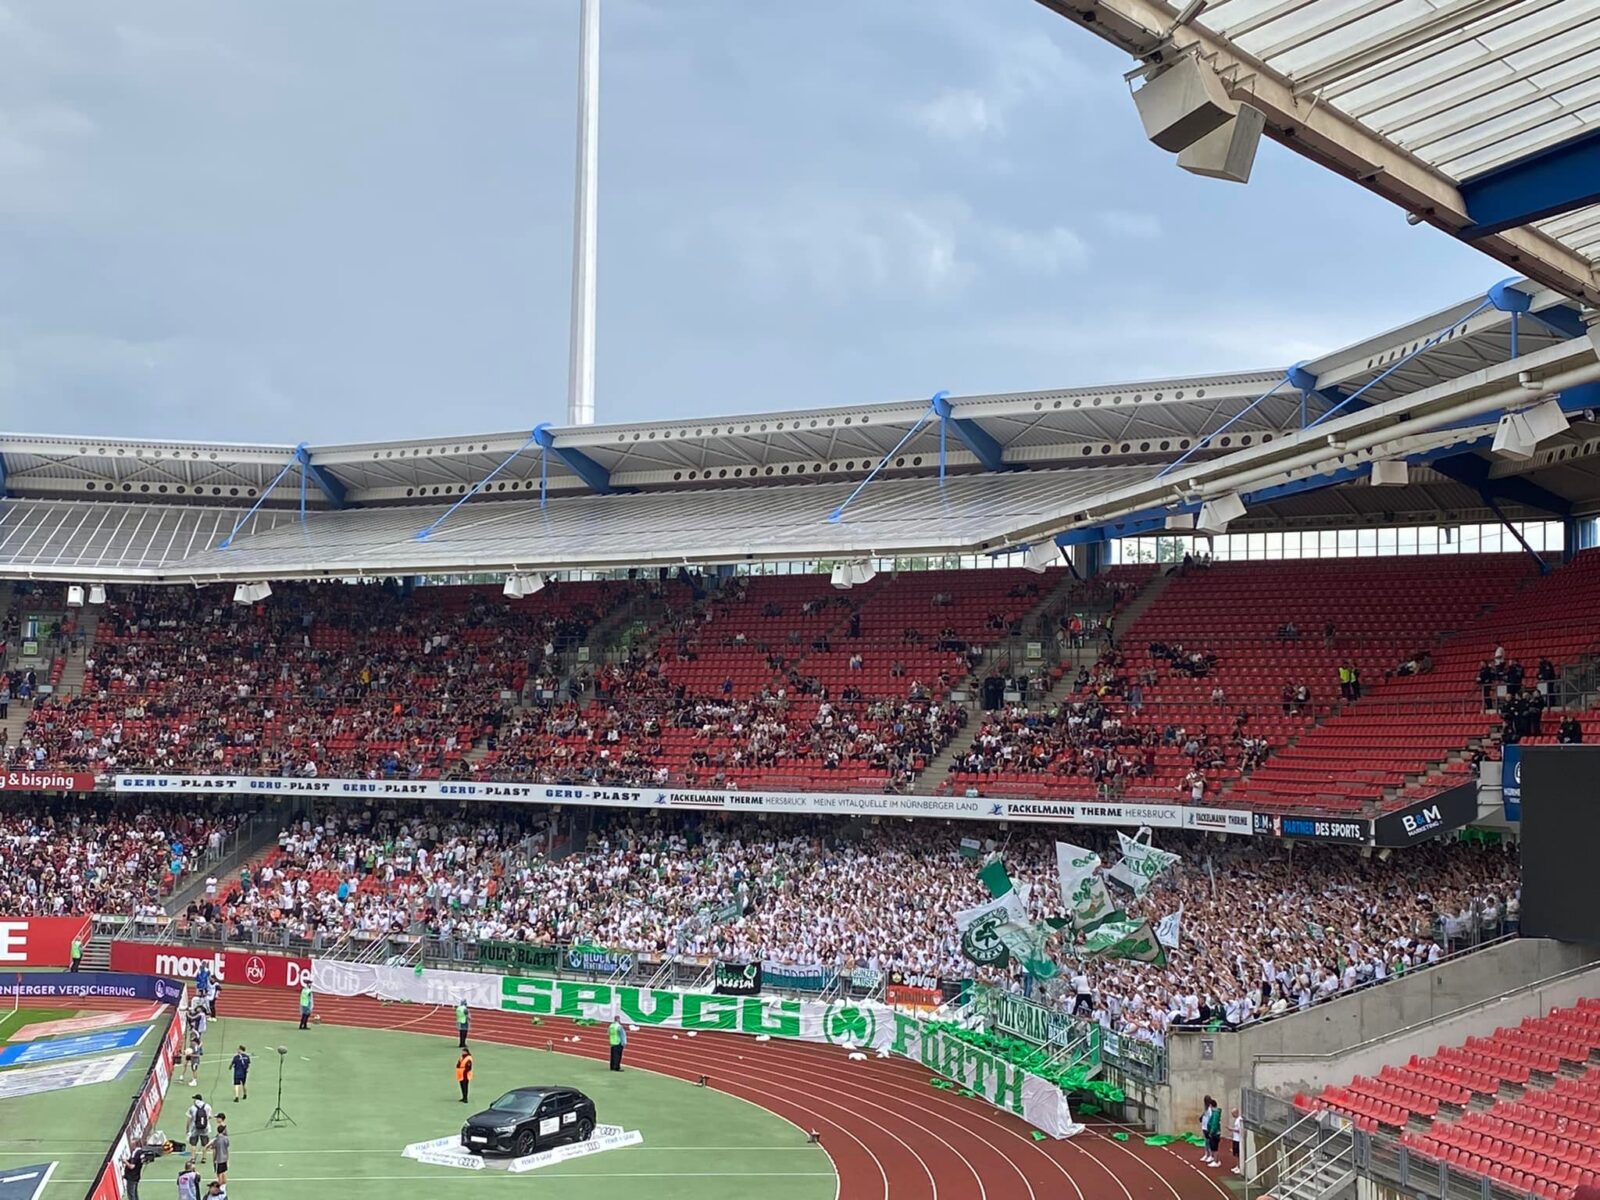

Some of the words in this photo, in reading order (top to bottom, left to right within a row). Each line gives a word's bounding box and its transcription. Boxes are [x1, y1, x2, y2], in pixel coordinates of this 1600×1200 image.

[8, 773, 20, 786] &
[22, 773, 74, 789] bisping
[671, 794, 725, 804] FACKELMANN
[730, 796, 763, 805] THERME
[765, 796, 807, 806] HERSBRUCK
[813, 799, 836, 807] MEINE
[838, 799, 888, 809] VITALQUELLE
[889, 800, 898, 808] IM
[900, 800, 955, 810] NÜRNBERGER
[956, 802, 978, 811] LAND
[1008, 804, 1075, 815] FACKELMANN
[1081, 807, 1122, 817] THERME
[1125, 808, 1176, 820] HERSBRUCK
[1402, 805, 1441, 831] B&M
[1283, 820, 1314, 835] PARTNER
[1315, 822, 1330, 836] DES
[0, 922, 29, 961] E
[480, 945, 509, 961] KULT
[517, 948, 558, 966] BLATT
[247, 967, 263, 978] FCN
[903, 972, 938, 991] SpVgg
[59, 985, 136, 997] VERSICHERUNG
[501, 977, 800, 1036] SPVGG
